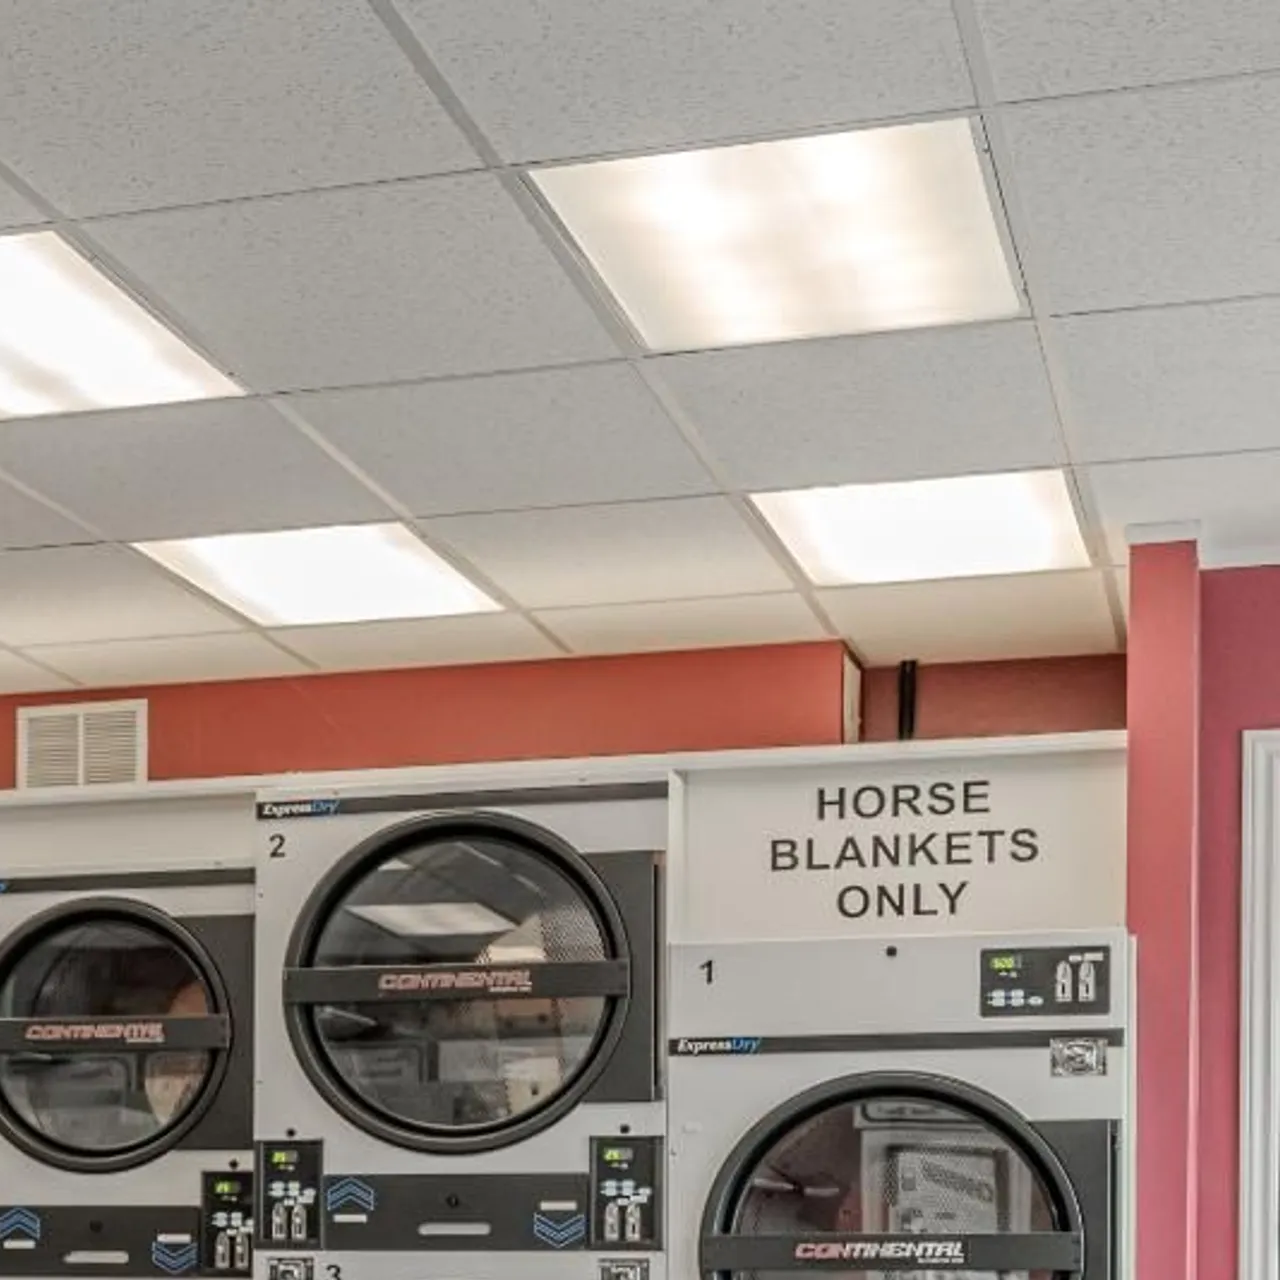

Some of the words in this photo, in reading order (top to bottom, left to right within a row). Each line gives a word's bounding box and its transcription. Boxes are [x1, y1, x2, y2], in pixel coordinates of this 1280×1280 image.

[815, 779, 992, 821] HORSE
[269, 833, 286, 858] 2
[769, 827, 1040, 873] BLANKETS
[836, 880, 971, 919] ONLY
[377, 969, 533, 990] CONTINENTAL
[699, 960, 713, 985] 1
[25, 1022, 164, 1040] CONTINENTAL
[795, 1241, 965, 1259] CONTINENTAL
